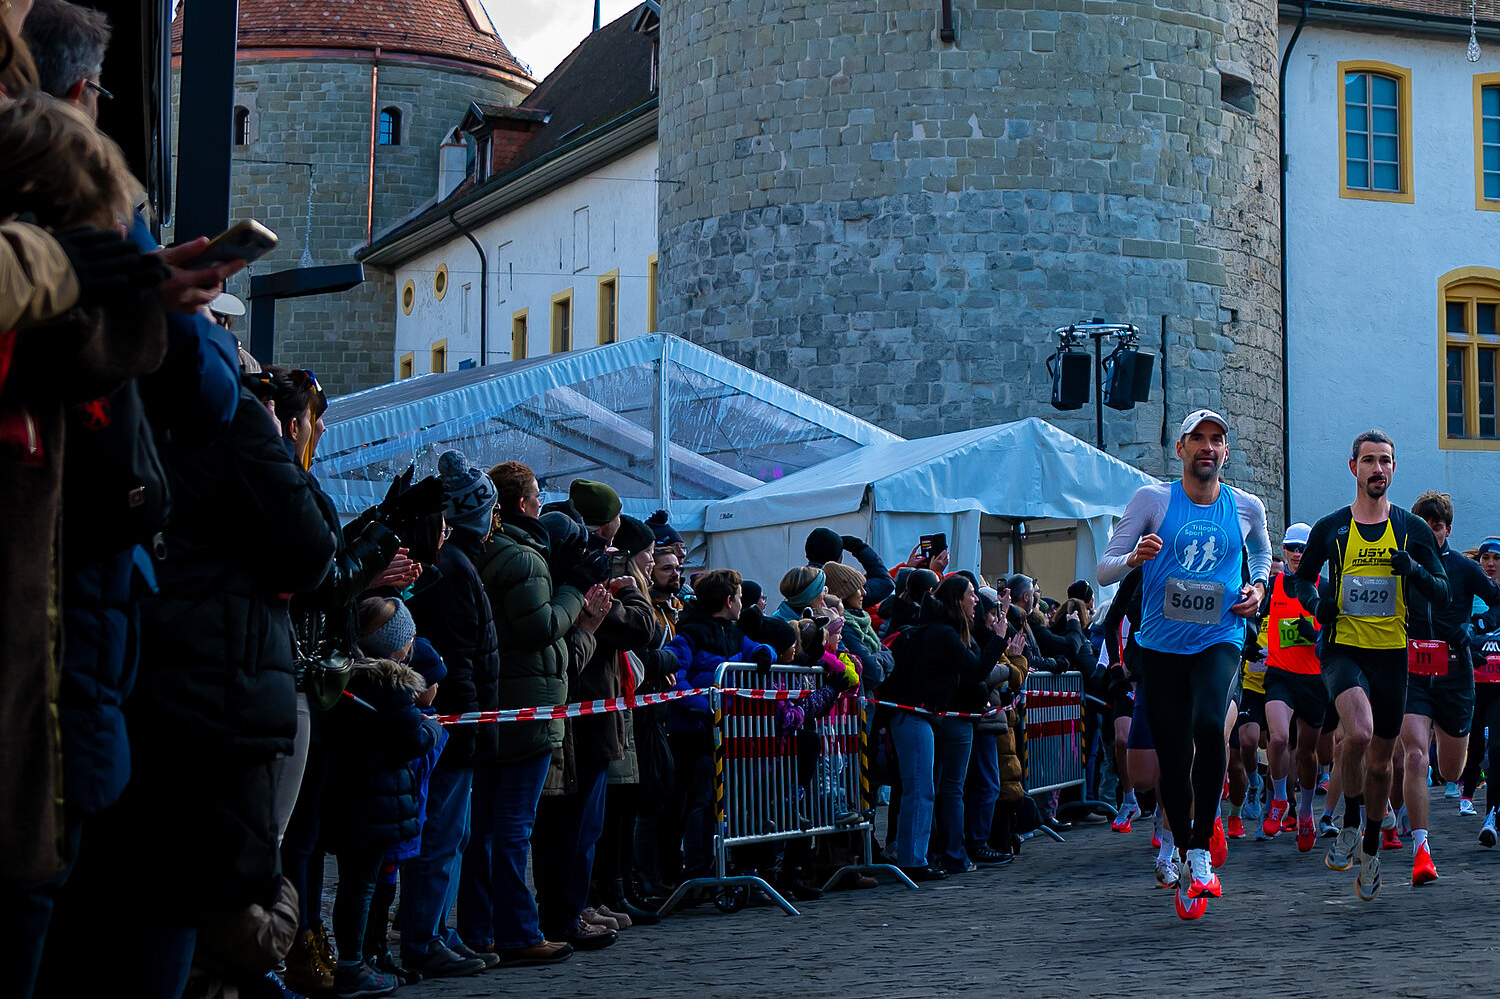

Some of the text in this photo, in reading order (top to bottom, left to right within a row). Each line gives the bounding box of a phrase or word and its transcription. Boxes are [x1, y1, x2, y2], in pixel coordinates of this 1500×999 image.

[1184, 529, 1204, 537] Sport
[1192, 524, 1218, 532] Trilogie
[1358, 548, 1387, 558] USY
[1349, 589, 1389, 603] 5429
[1171, 593, 1215, 611] 5608
[1416, 652, 1432, 664] 111
